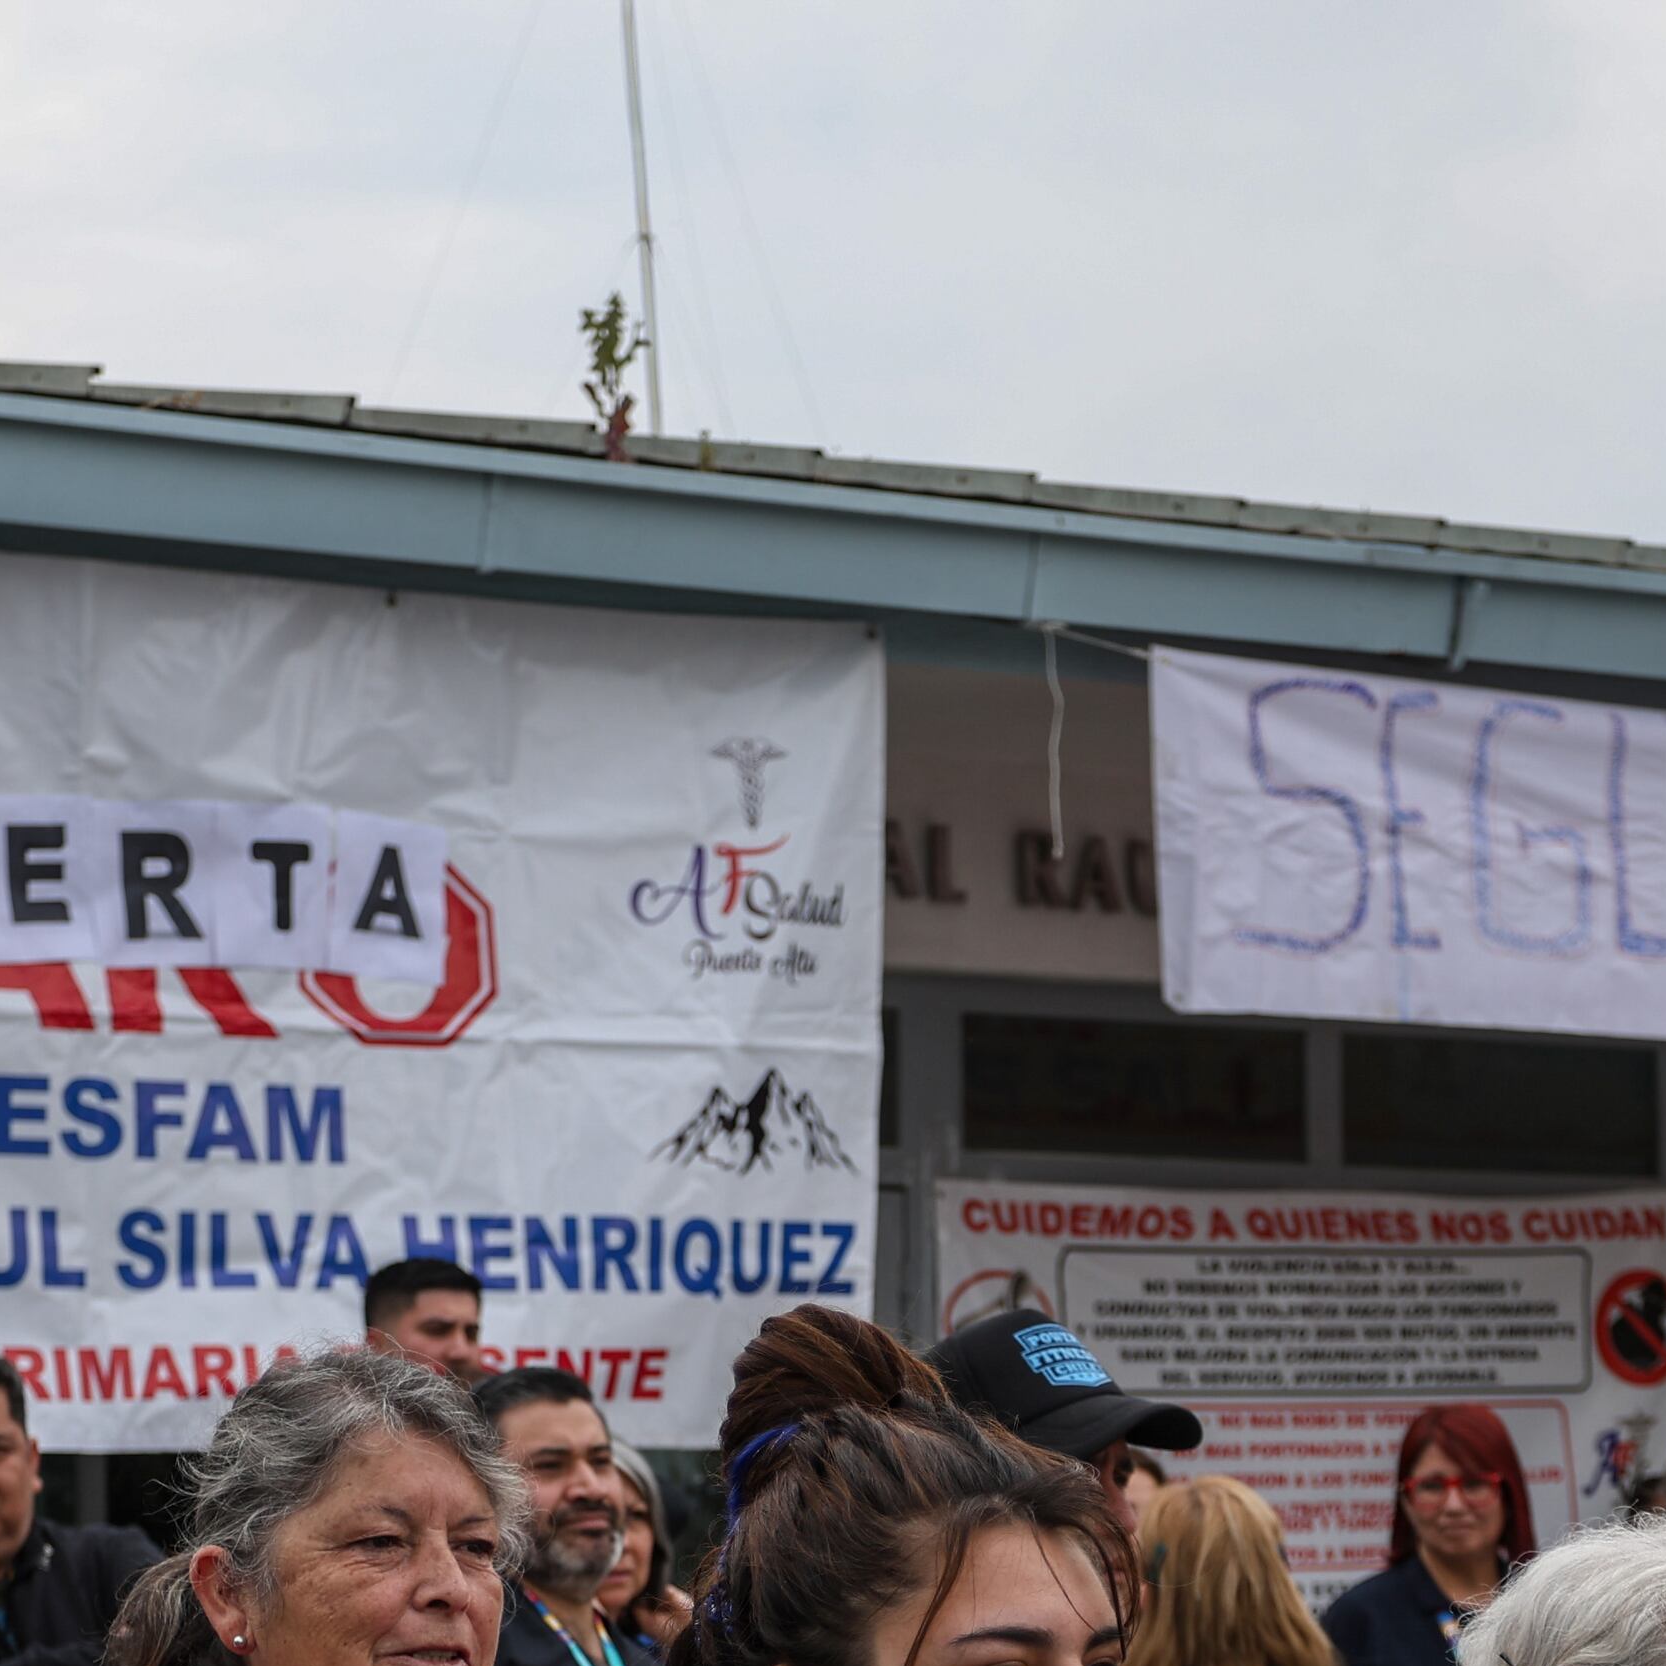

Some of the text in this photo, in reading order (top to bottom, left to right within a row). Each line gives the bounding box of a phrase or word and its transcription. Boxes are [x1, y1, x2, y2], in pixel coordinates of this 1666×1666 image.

[117, 1208, 370, 1290] SILVA
[402, 1213, 857, 1298] HENRIQUEZ
[963, 1200, 1666, 1245] CUIDEMOS A QUIENES NOS CUIDAN
